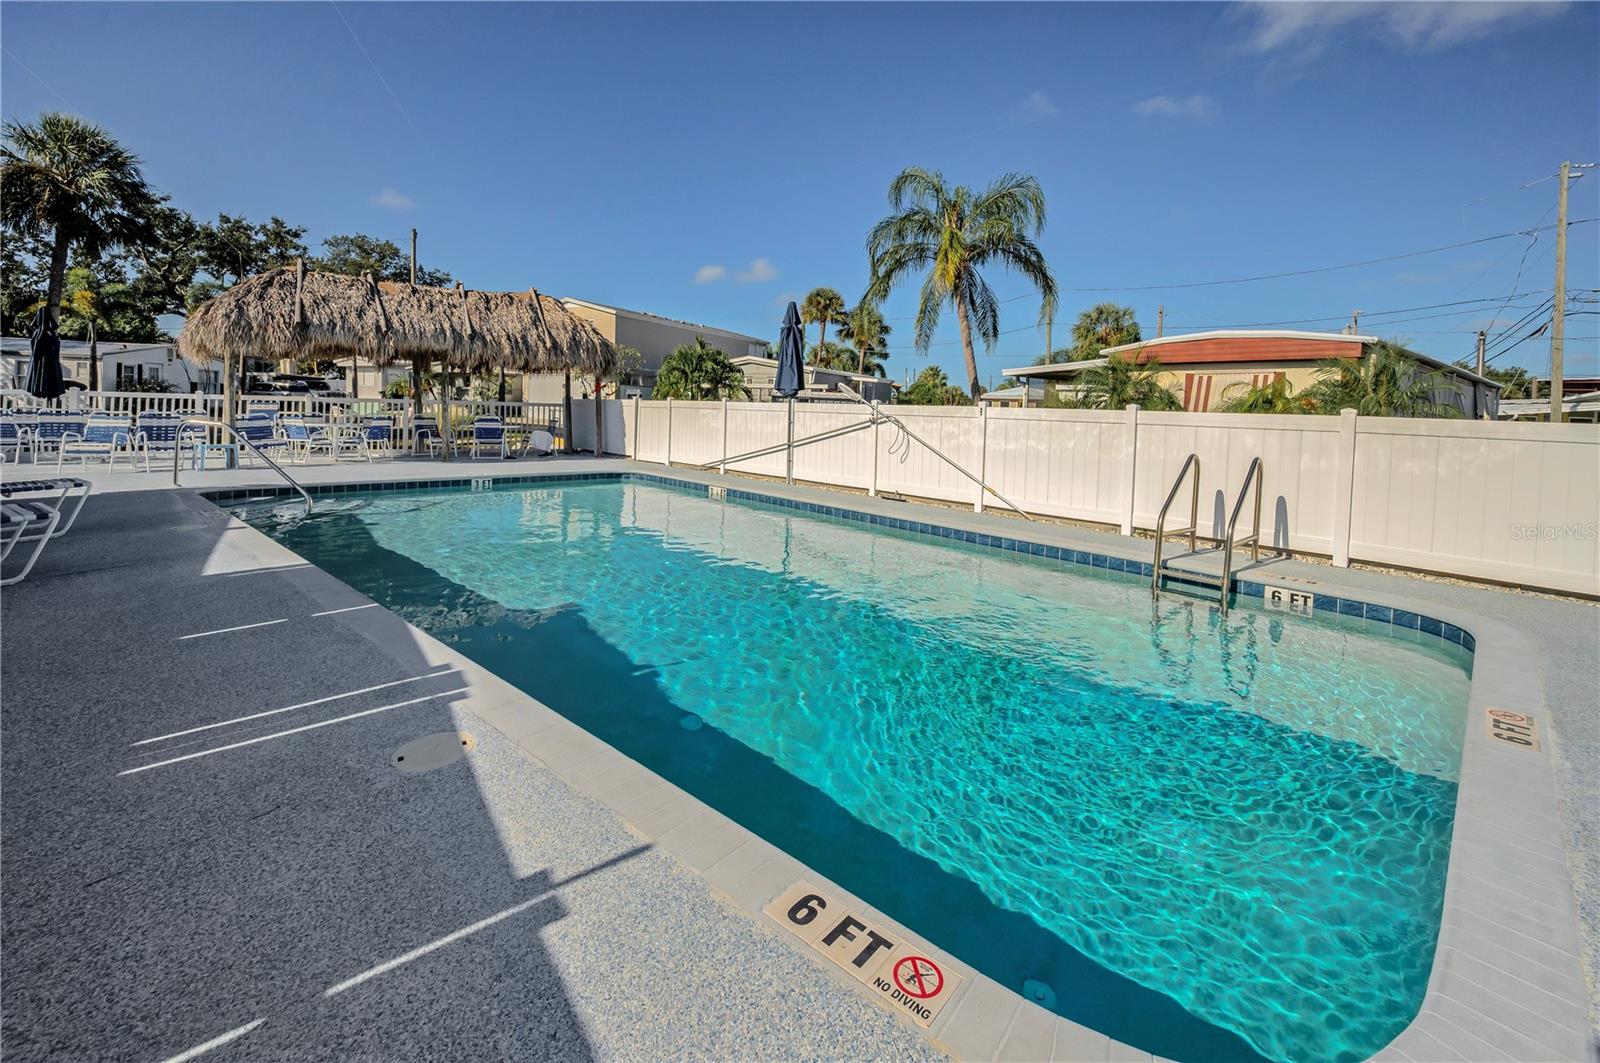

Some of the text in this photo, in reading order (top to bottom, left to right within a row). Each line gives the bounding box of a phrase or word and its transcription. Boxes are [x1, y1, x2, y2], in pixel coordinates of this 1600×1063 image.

[1272, 590, 1312, 607] 6 FT
[1492, 718, 1533, 746] 6 FT
[787, 893, 895, 969] 6 FT
[873, 976, 932, 1020] NO DIVING
